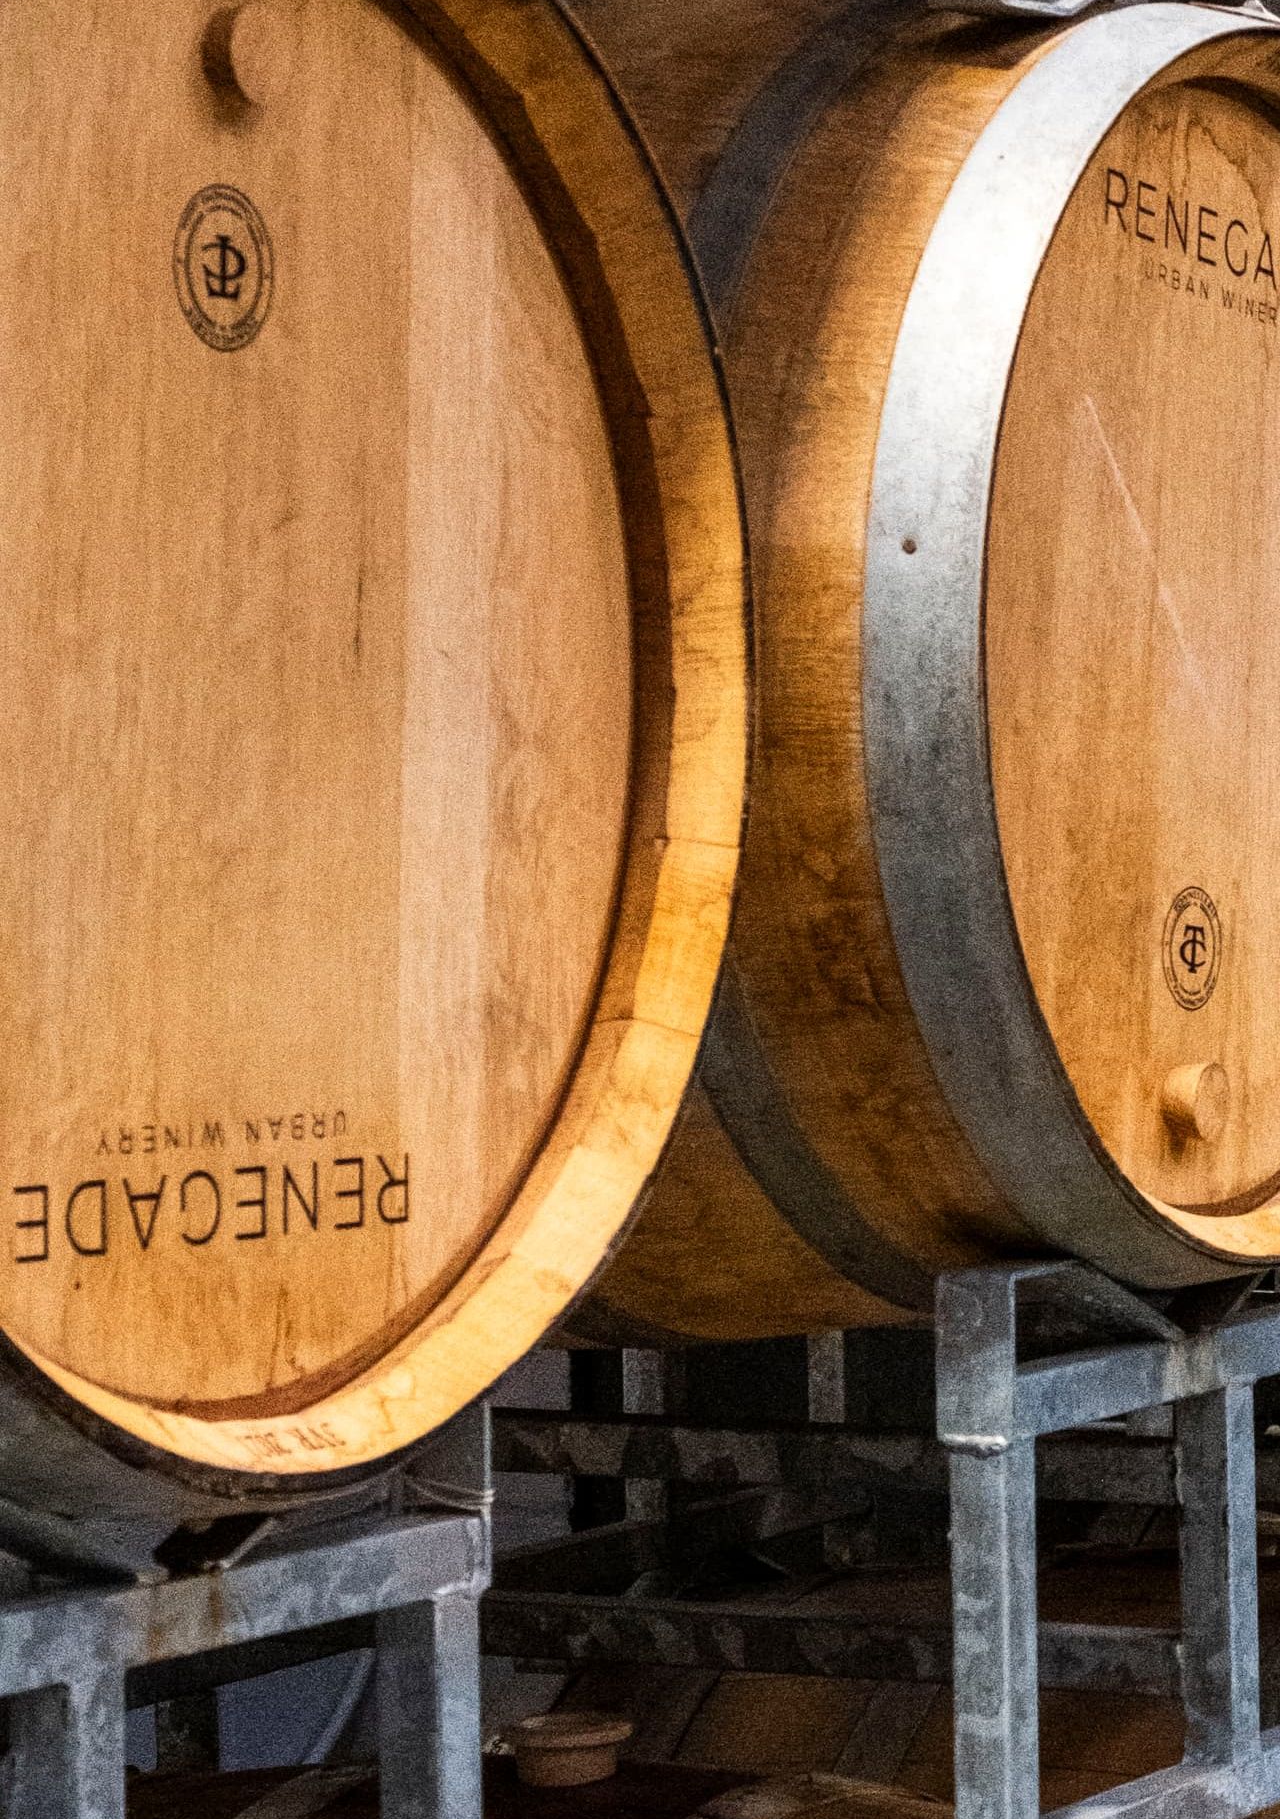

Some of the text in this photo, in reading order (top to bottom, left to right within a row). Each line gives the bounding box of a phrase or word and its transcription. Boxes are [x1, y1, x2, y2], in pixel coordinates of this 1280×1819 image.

[1145, 262, 1209, 301] URBAN
[97, 1110, 347, 1156] URBAN WINERY
[12, 1152, 410, 1264] RENEGADE
